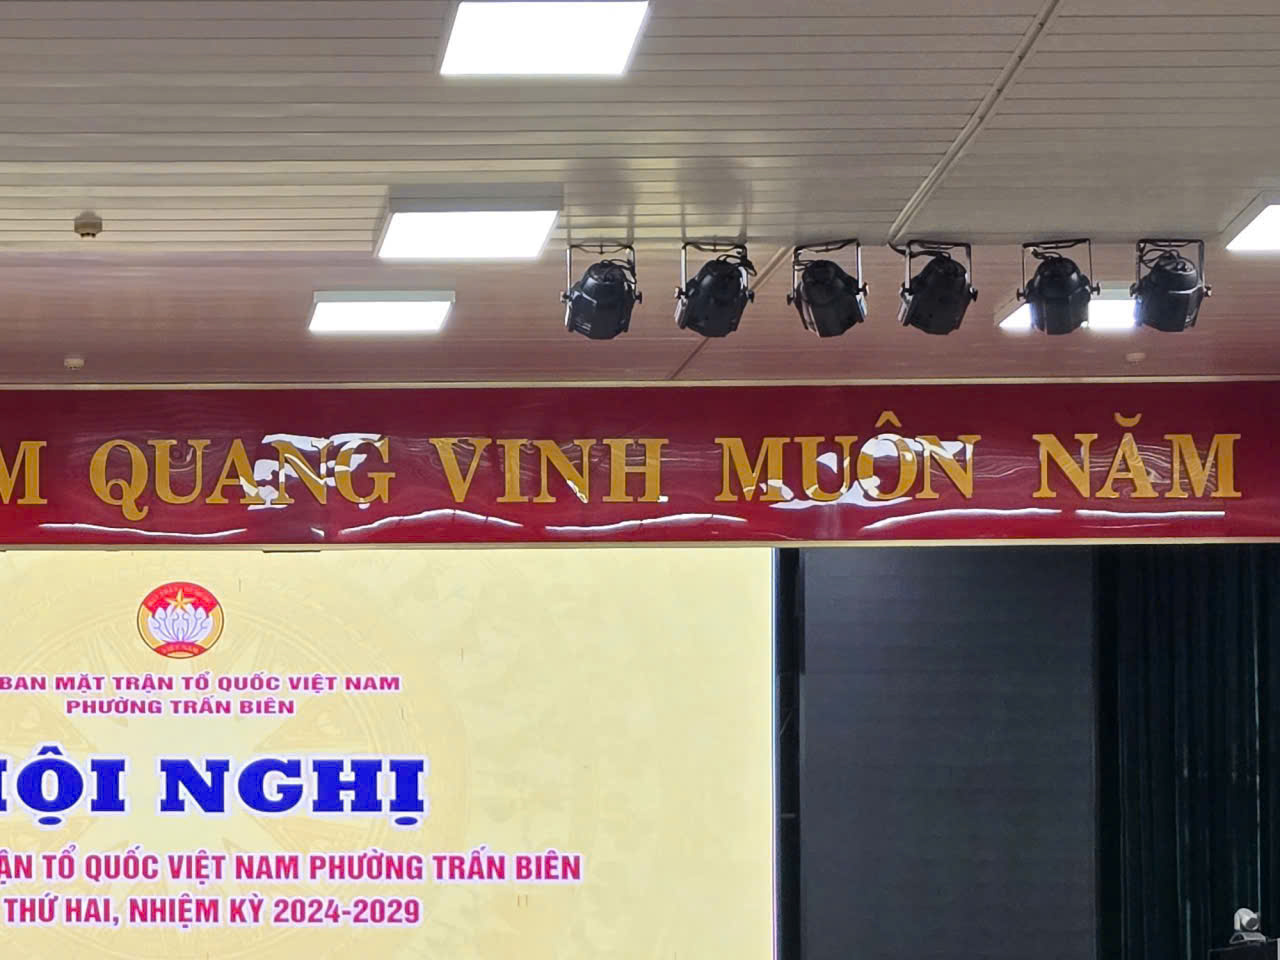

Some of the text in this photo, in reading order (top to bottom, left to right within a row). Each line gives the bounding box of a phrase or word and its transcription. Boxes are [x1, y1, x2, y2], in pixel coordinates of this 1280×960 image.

[89, 436, 396, 521] QUANG
[429, 436, 670, 504] VINH
[714, 410, 982, 502] MUÔN
[1032, 412, 1242, 499] NĂM
[55, 674, 105, 695] MẶT
[112, 673, 173, 695] TRẬN
[181, 671, 212, 691] TỔ
[218, 671, 280, 692] QUỐC
[289, 673, 337, 695] VIỆT
[345, 676, 400, 691] NAM
[66, 695, 295, 714] PHƯỜNG TRẤN BIÊN
[160, 758, 425, 826] NGHỊ
[42, 844, 76, 880] TỔ
[85, 845, 159, 882] QUỐC
[168, 850, 226, 885] VIỆT
[235, 855, 299, 880] NAM
[309, 849, 422, 881] PHƯỜNG
[432, 845, 505, 880] TRẤN
[515, 850, 581, 880] BIÊN
[3, 892, 58, 923] THỨ
[65, 898, 120, 927] HAI,
[129, 893, 219, 929] NHIỆM
[230, 893, 264, 923] KỲ
[273, 899, 420, 924] 2024-2029
